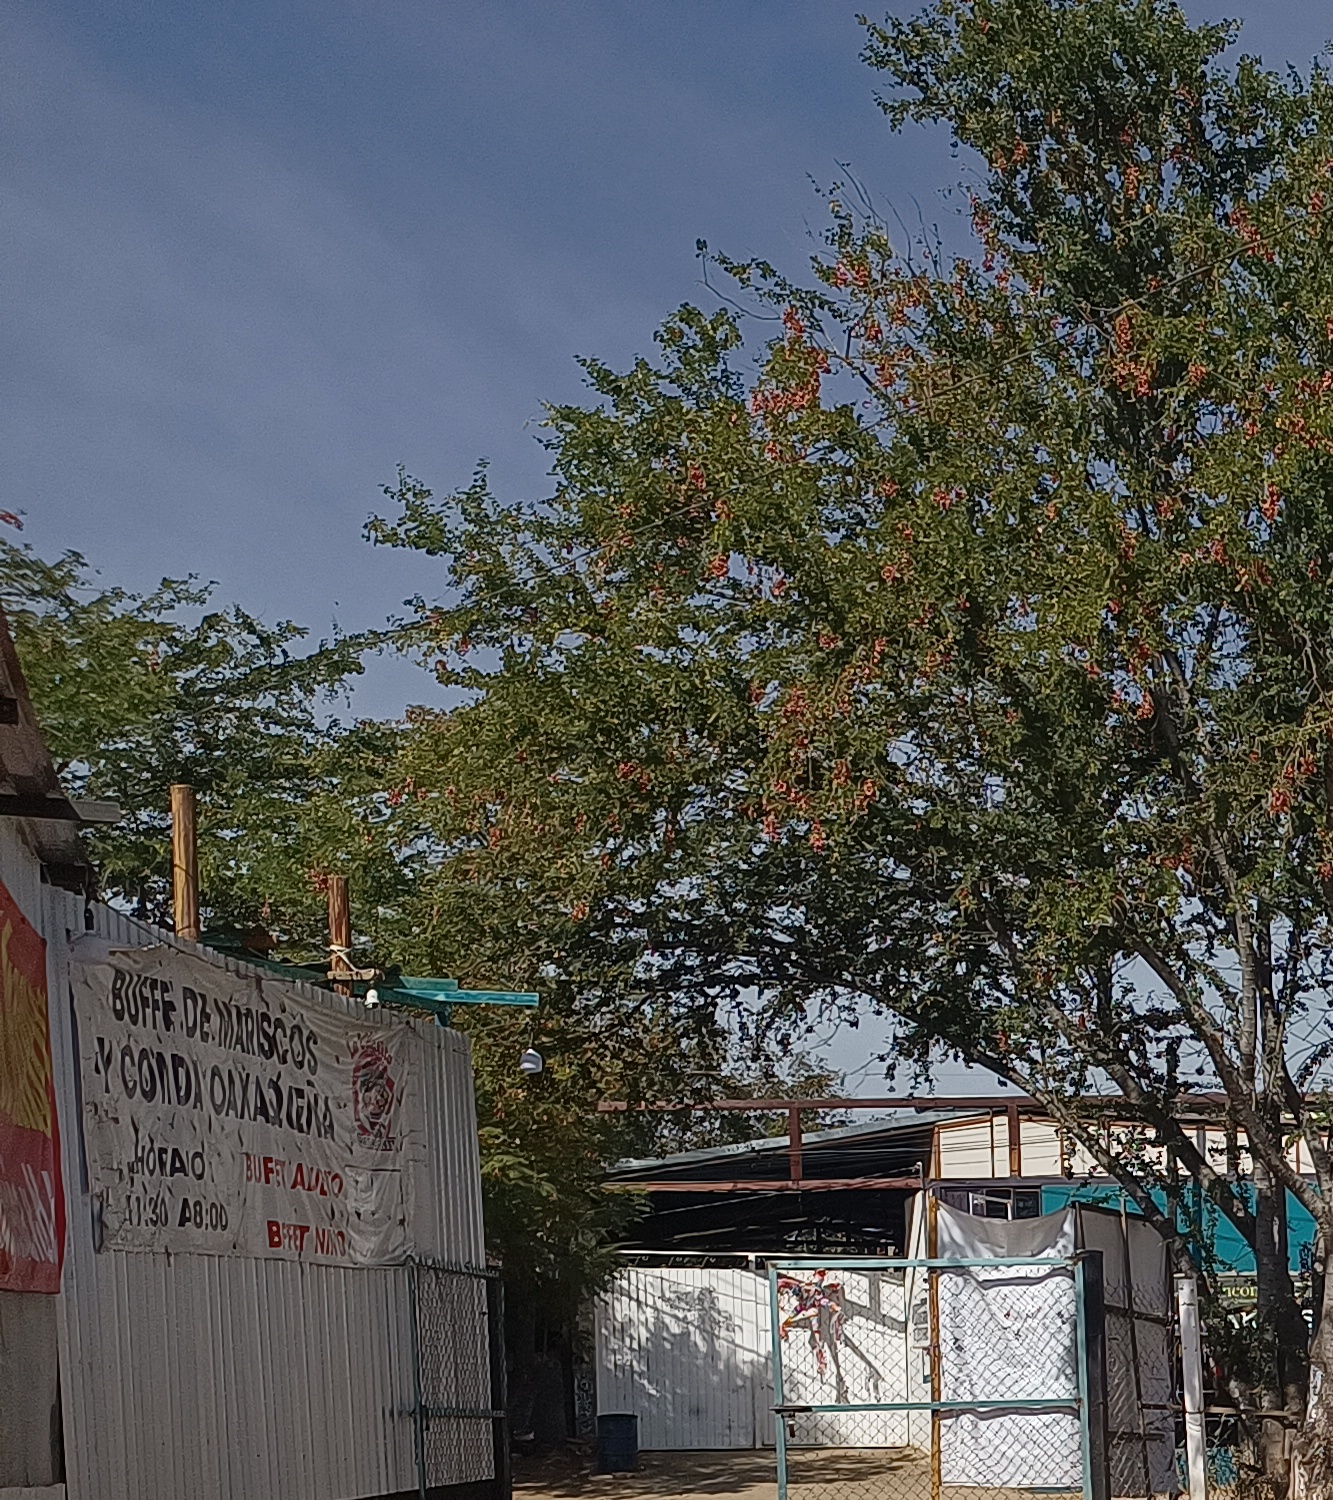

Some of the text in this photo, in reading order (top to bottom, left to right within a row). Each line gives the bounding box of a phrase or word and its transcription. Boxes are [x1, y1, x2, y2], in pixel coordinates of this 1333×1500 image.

[98, 1036, 114, 1095] Y
[182, 986, 212, 1044] DE
[213, 998, 319, 1077] MARISCOS
